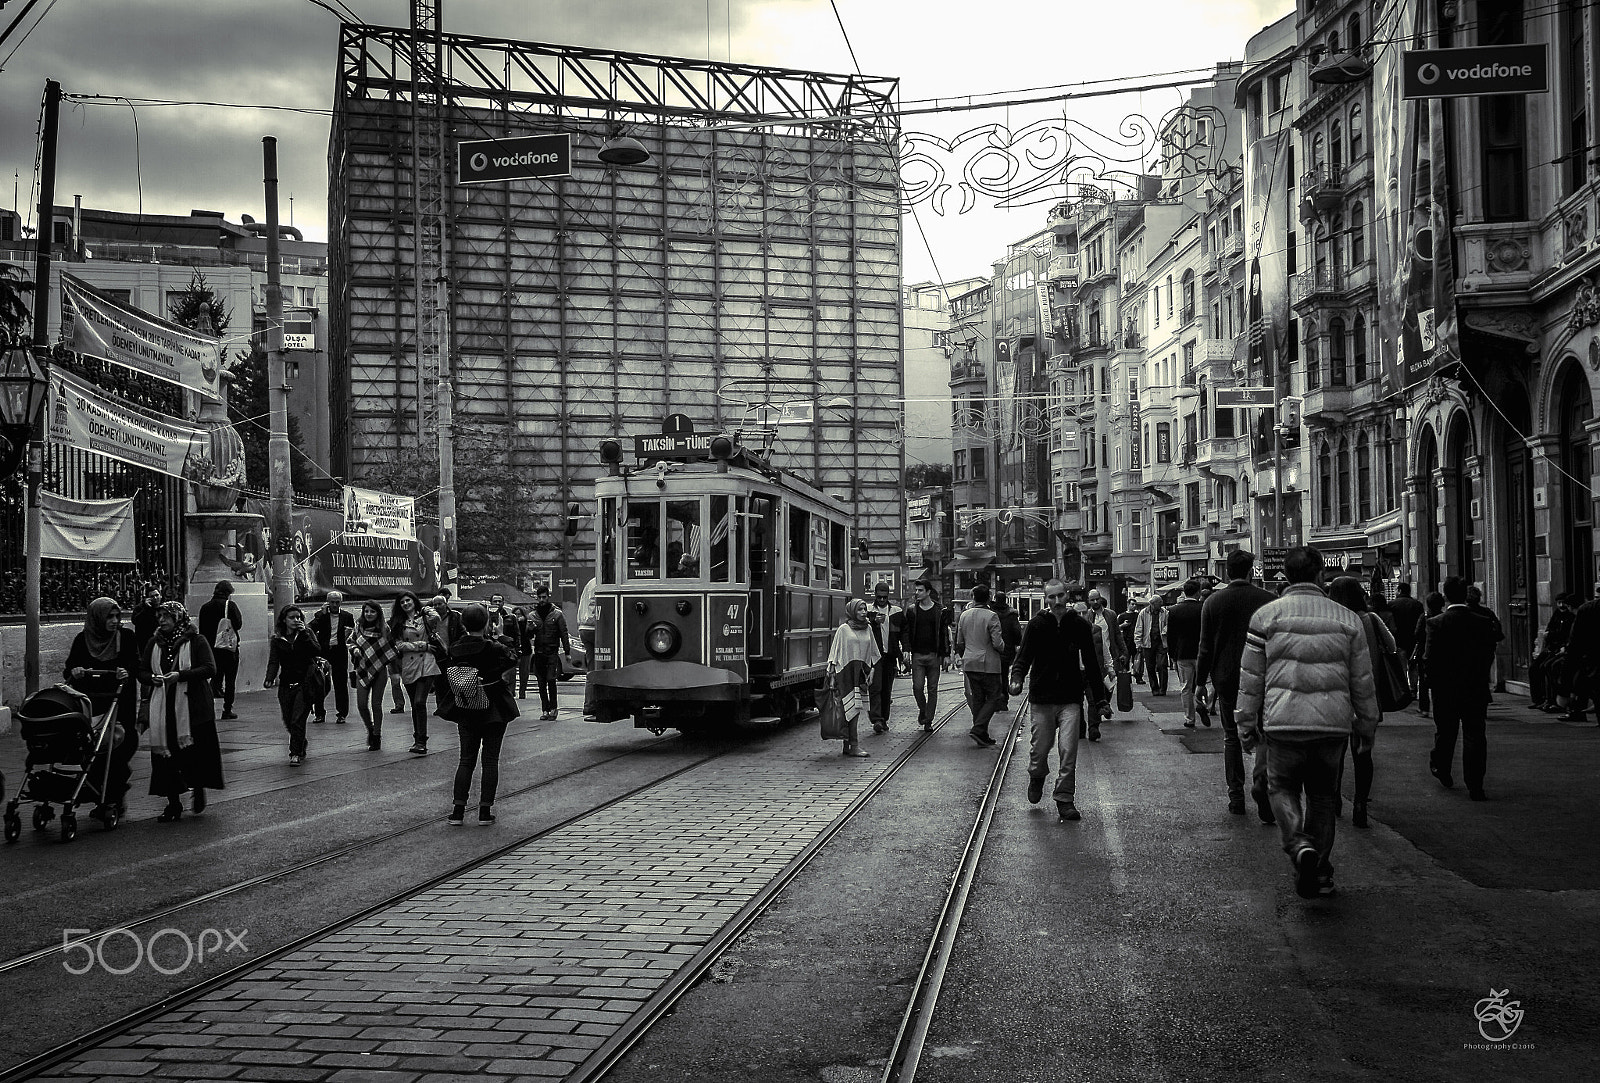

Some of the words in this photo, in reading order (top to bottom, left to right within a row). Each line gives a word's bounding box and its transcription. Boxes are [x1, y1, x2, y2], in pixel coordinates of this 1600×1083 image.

[1446, 62, 1532, 80] vodafone
[492, 151, 559, 167] vodafone
[111, 331, 138, 353] ÖDEMEYİ
[148, 331, 161, 347] 2015
[161, 334, 184, 355] TARİHİNE
[184, 345, 201, 362] KADAR
[76, 397, 86, 411] 30
[87, 402, 109, 420] KASIM
[88, 418, 121, 444] ÖDEMEYİ
[675, 415, 680, 431] 1
[641, 435, 675, 452] TAKSİM
[685, 434, 711, 450] TÜNE
[330, 529, 341, 545] BU
[331, 550, 344, 568] YÜZ
[346, 554, 358, 568] YIL
[359, 552, 375, 569] ÖNCE
[1167, 569, 1178, 578] CAFE
[727, 604, 739, 620] 47
